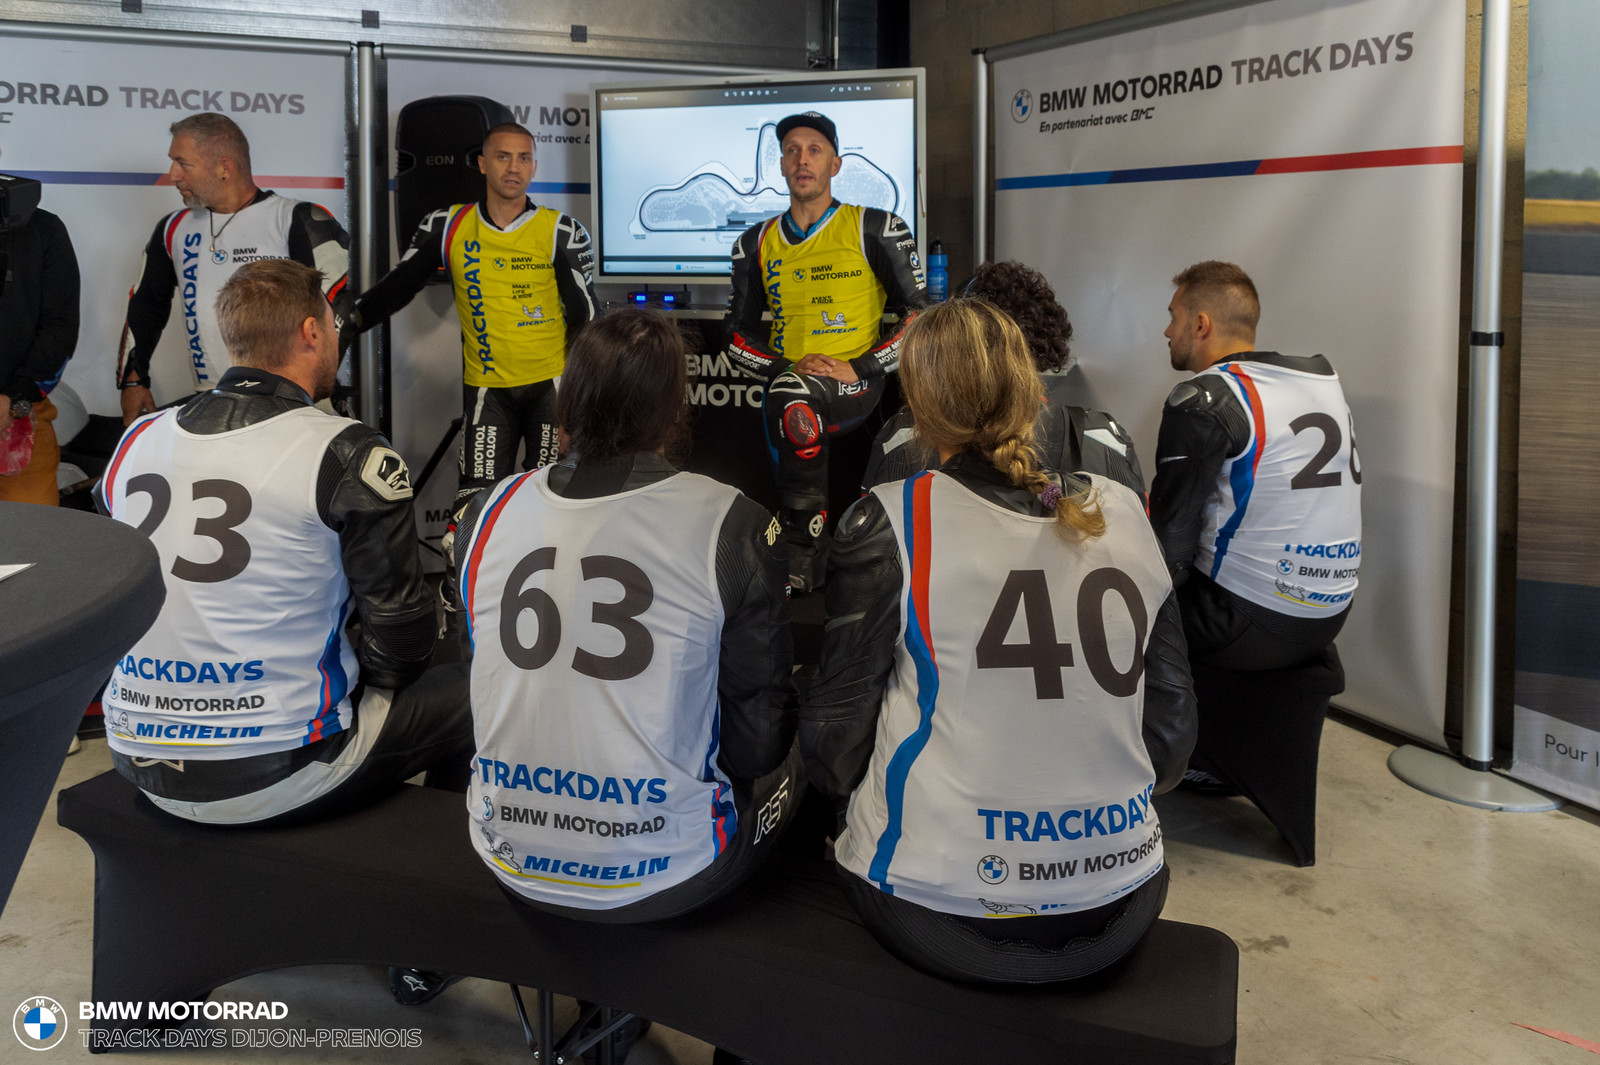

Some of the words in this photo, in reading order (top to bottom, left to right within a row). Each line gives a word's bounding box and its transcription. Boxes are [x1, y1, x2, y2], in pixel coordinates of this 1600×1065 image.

[1040, 86, 1087, 113] BMW
[1093, 64, 1223, 106] MOTORRAD
[1231, 45, 1324, 85] TRACK
[1329, 31, 1414, 71] DAYS
[0, 81, 109, 107] ORRAD
[119, 86, 224, 112] TRACK
[230, 91, 305, 115] DAYS
[507, 105, 531, 125] W
[1040, 121, 1051, 133] En
[1051, 114, 1103, 134] partenariat
[1105, 113, 1128, 124] avec
[554, 135, 582, 144] avec
[232, 247, 258, 256] BMW
[811, 264, 833, 274] BMW
[811, 269, 863, 281] MOTORRAD
[183, 232, 208, 385] TRACKDAYS
[463, 240, 496, 375] TRACKDAYS
[766, 259, 786, 356] ACKDAYS
[486, 425, 498, 458] MOTO
[540, 423, 551, 447] RIDE
[474, 425, 486, 479] TOULOUSE
[125, 473, 252, 583] 23
[1298, 566, 1331, 579] BMW
[499, 546, 654, 681] 63
[975, 567, 1148, 699] 40
[121, 687, 151, 708] BMW
[155, 694, 265, 712] MOTORRAD
[136, 722, 264, 739] MICHELIN
[1545, 733, 1589, 762] Pour
[478, 757, 667, 805] TRACKDAYS
[500, 805, 549, 827] BMW
[553, 812, 666, 838] MOTORRAD
[523, 855, 671, 880] MICHELIN
[1018, 859, 1078, 881] BMW
[1083, 823, 1162, 874] MOTORRAD
